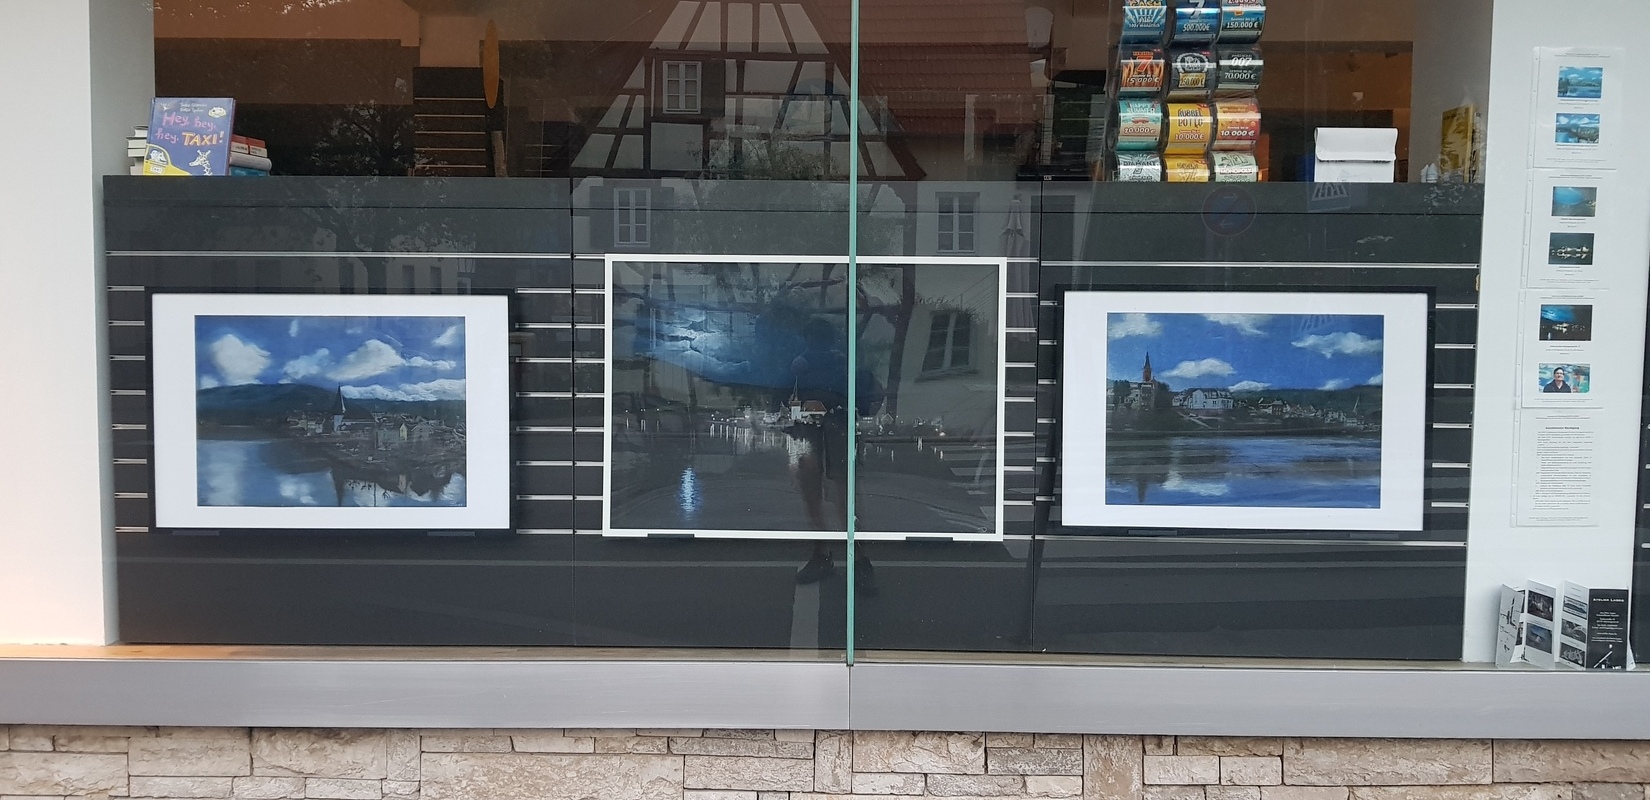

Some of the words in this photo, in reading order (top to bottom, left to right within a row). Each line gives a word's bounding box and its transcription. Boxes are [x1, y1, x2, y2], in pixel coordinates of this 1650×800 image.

[1136, 56, 1153, 72] 7
[1231, 57, 1252, 67] 007
[1224, 72, 1250, 80] 70.000
[182, 130, 225, 146] TAXI!
